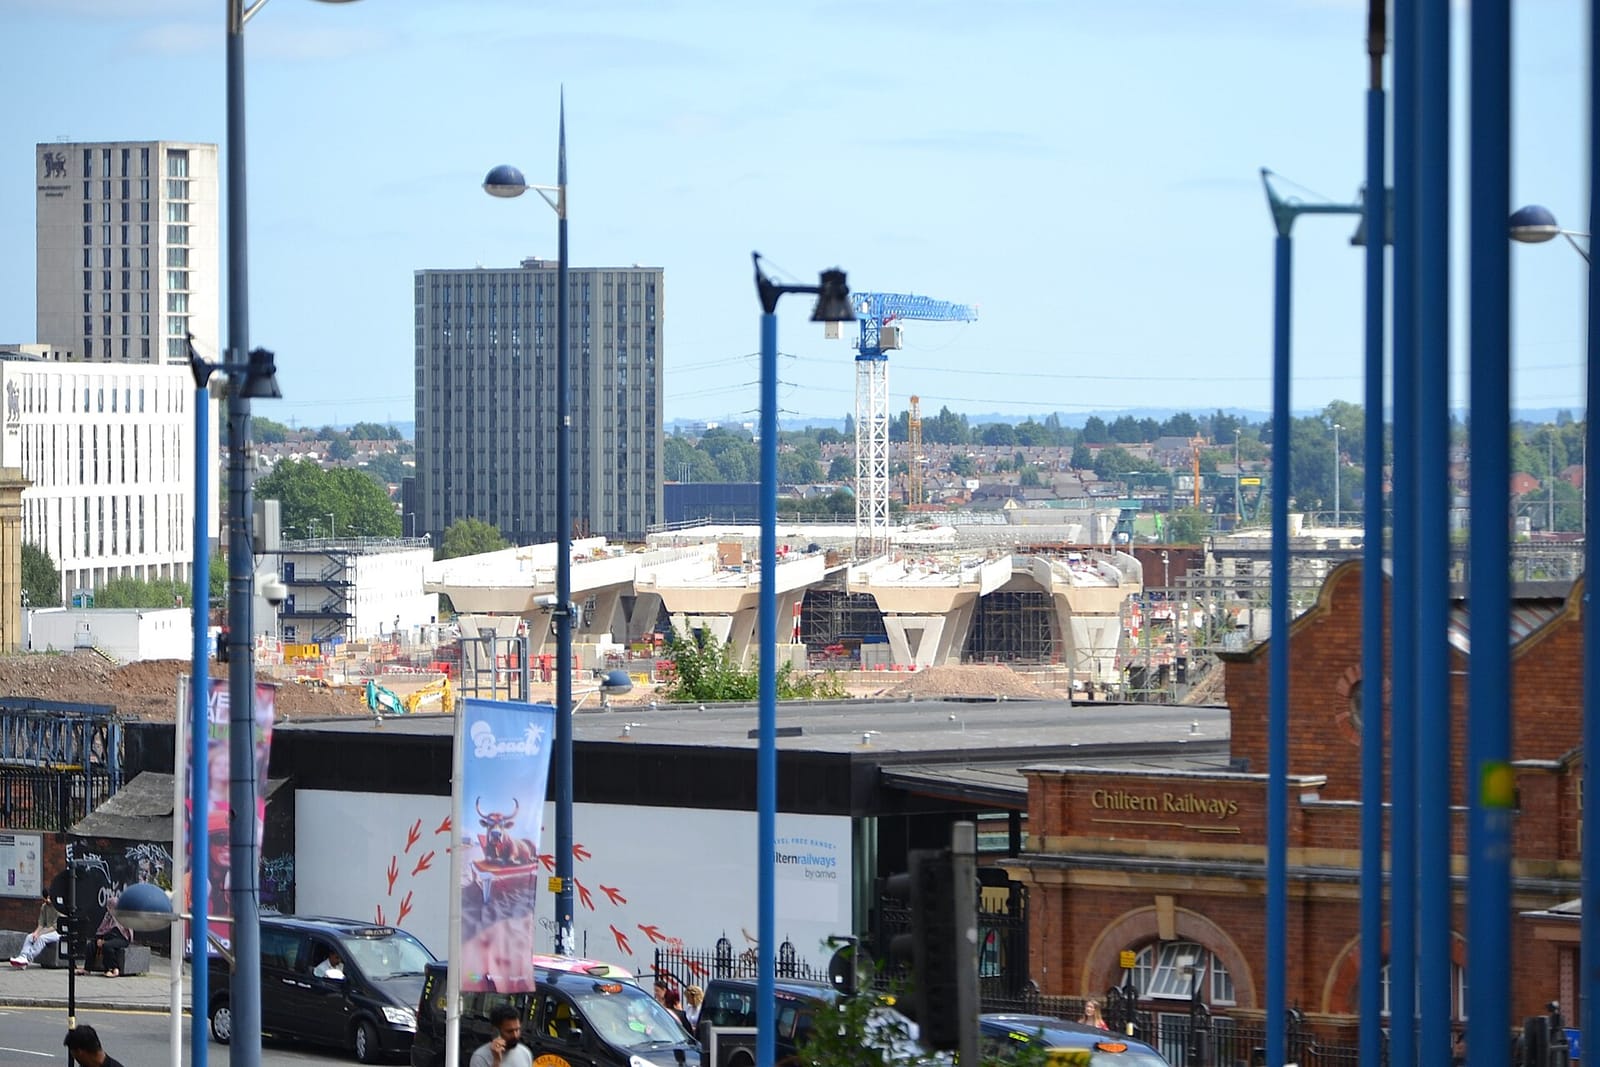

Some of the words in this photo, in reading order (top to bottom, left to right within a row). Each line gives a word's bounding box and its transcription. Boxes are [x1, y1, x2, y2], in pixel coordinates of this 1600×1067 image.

[1091, 789, 1158, 812] Chiltern
[1163, 792, 1238, 819] Railways
[774, 851, 836, 868] lternrailways
[805, 867, 814, 879] by
